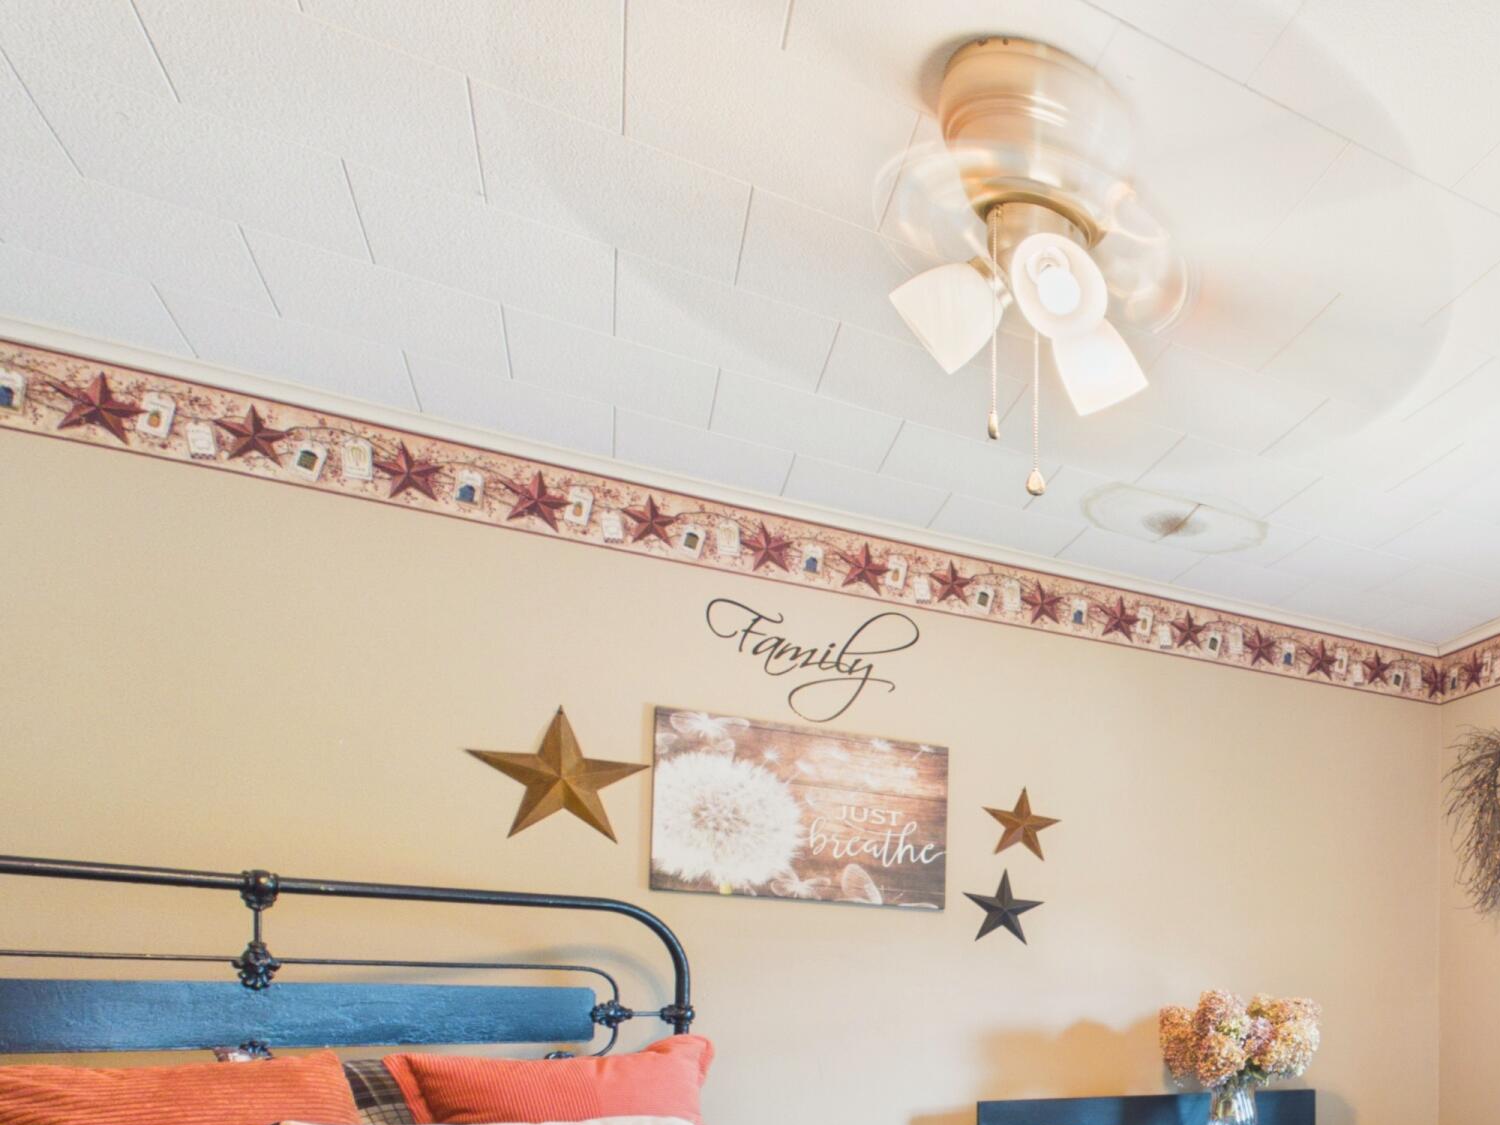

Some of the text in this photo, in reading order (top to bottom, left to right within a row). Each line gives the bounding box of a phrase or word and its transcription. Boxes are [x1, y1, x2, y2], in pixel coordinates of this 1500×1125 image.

[706, 597, 920, 723] Family
[837, 804, 903, 827] JUST
[809, 816, 946, 868] breathe
